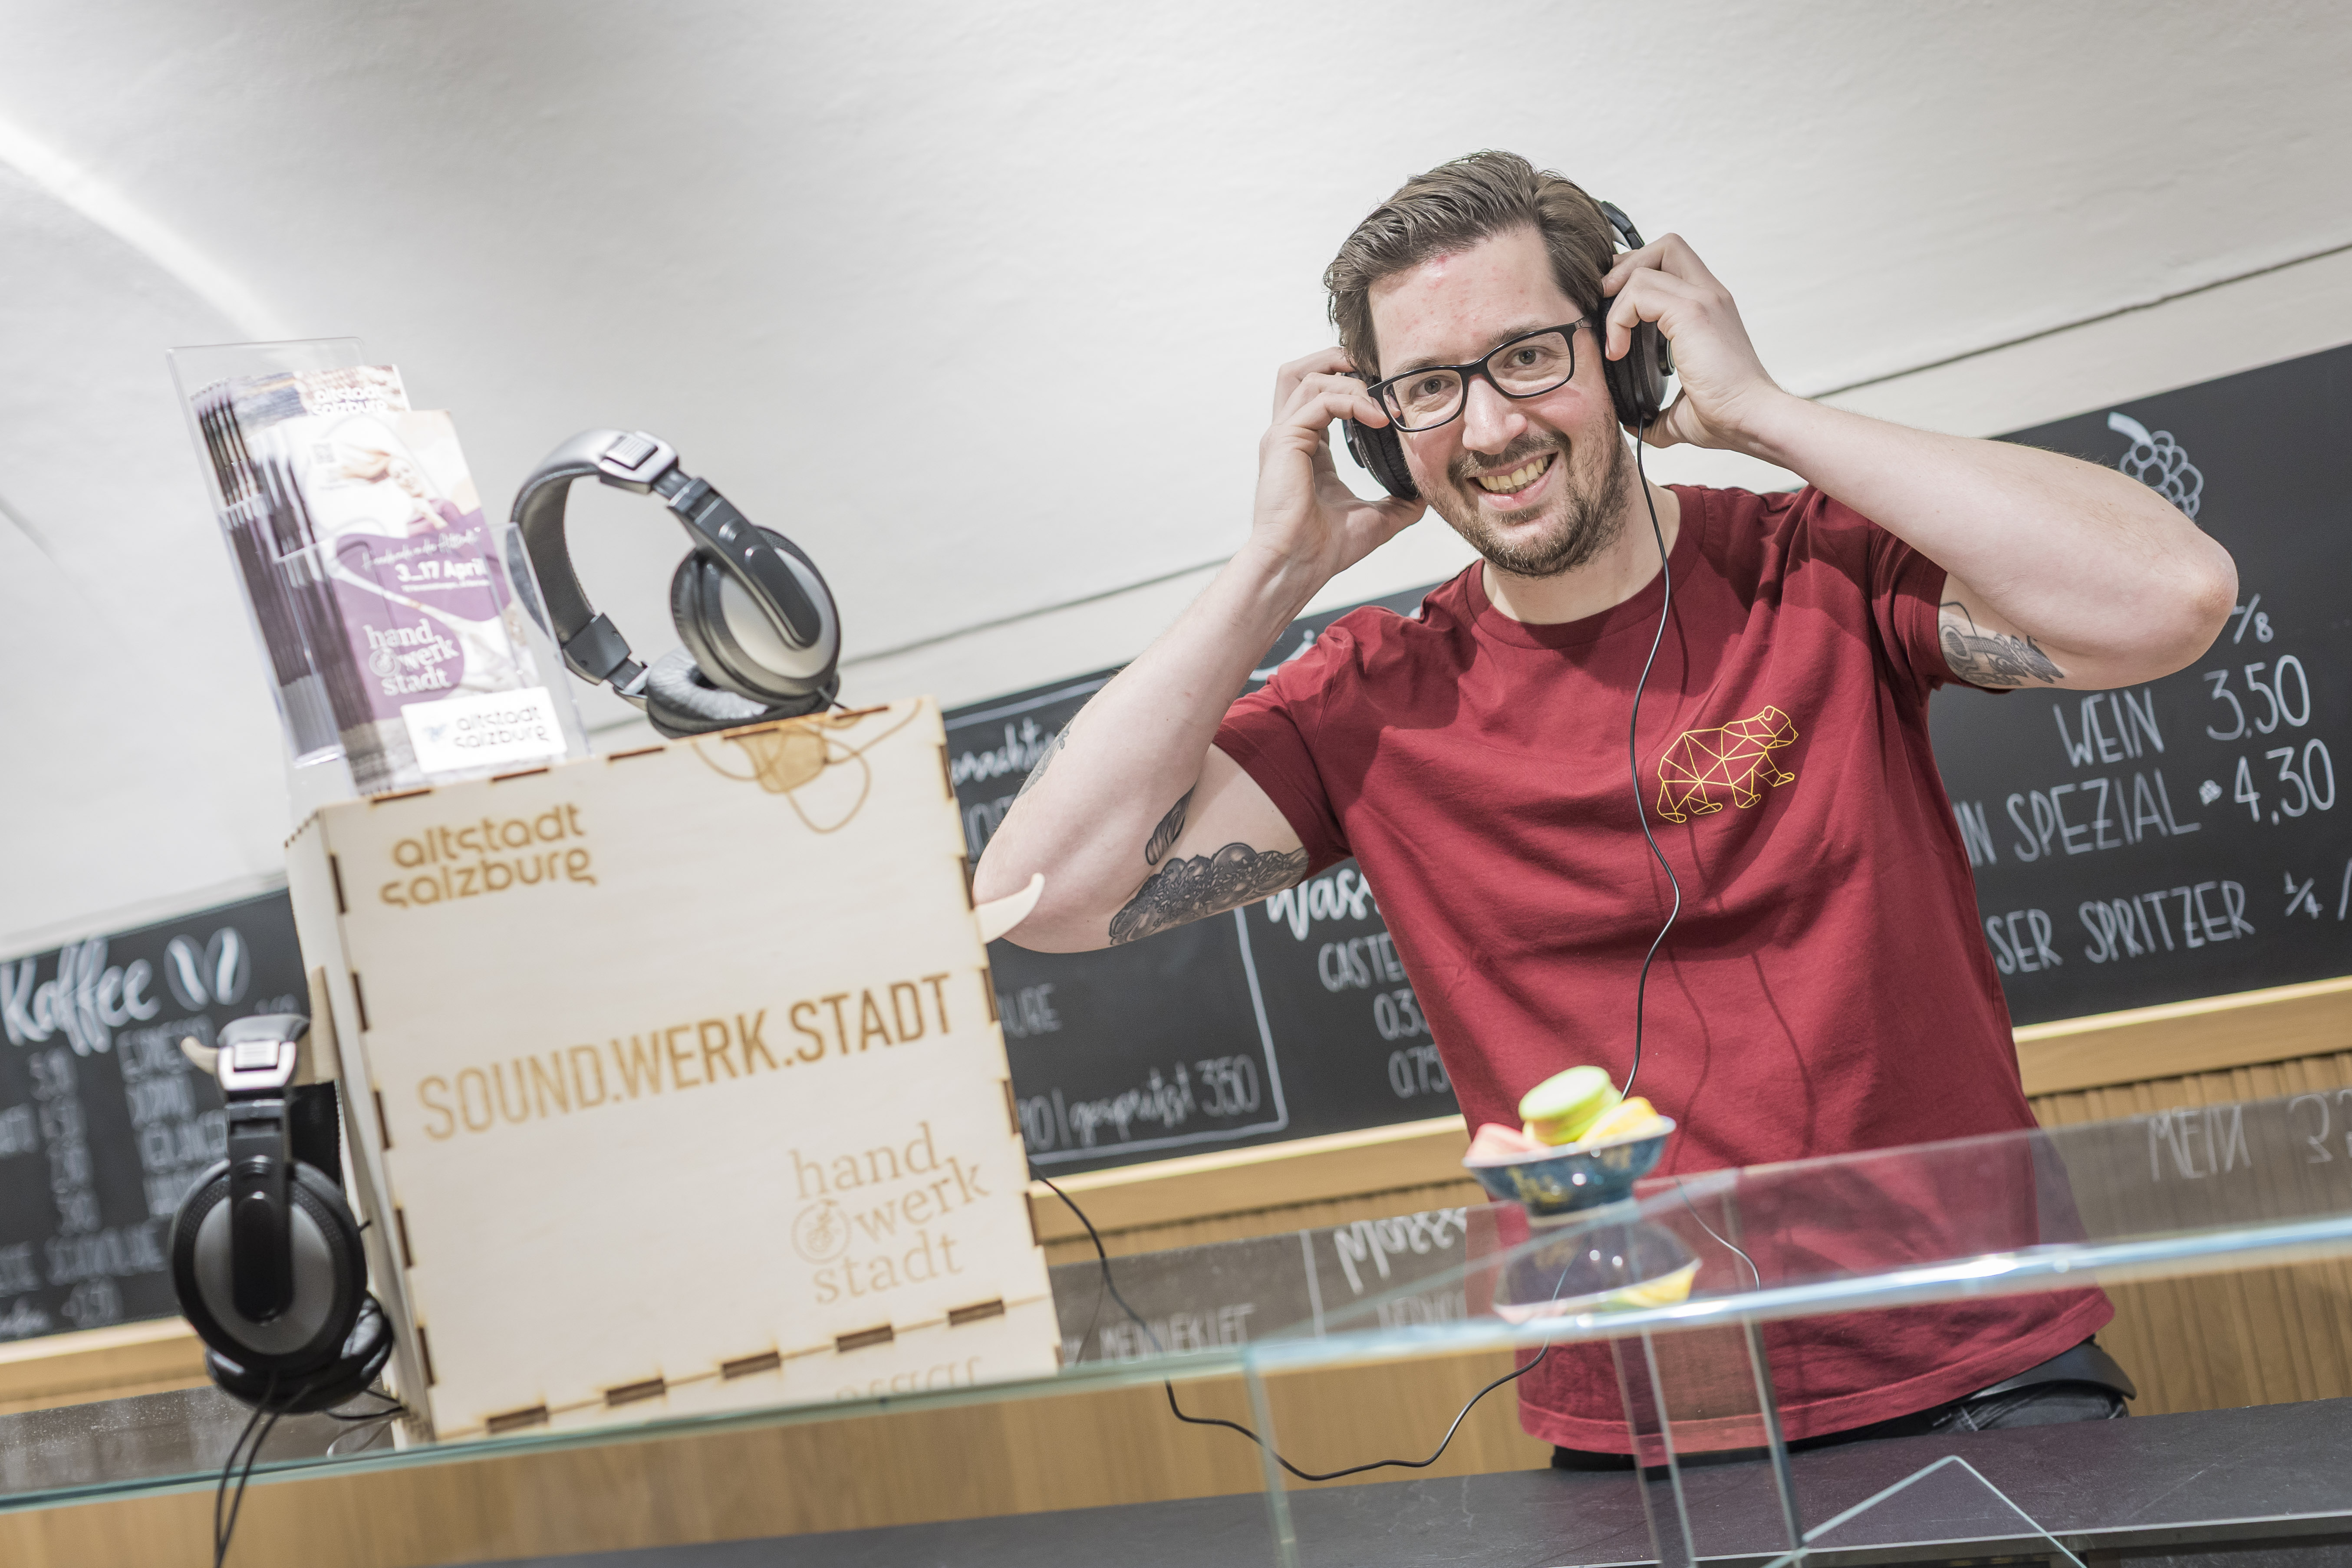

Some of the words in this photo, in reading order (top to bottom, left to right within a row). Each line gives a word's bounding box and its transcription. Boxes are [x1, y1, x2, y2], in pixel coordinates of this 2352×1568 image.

[444, 558, 488, 581] April
[363, 618, 435, 650] hand
[398, 634, 460, 671] werk
[381, 665, 454, 696] stadt
[456, 706, 543, 732] altstadt
[2052, 687, 2165, 768] WEIN
[392, 803, 587, 868] altstadt
[2006, 768, 2202, 863] SPEZIAL
[379, 847, 598, 909] salzburg
[2079, 880, 2256, 965] SPRITZER
[416, 972, 951, 1141] SOUND.WERK.STADT
[788, 1120, 941, 1200] hand
[854, 1156, 992, 1243] werk
[812, 1229, 964, 1304] stadt
